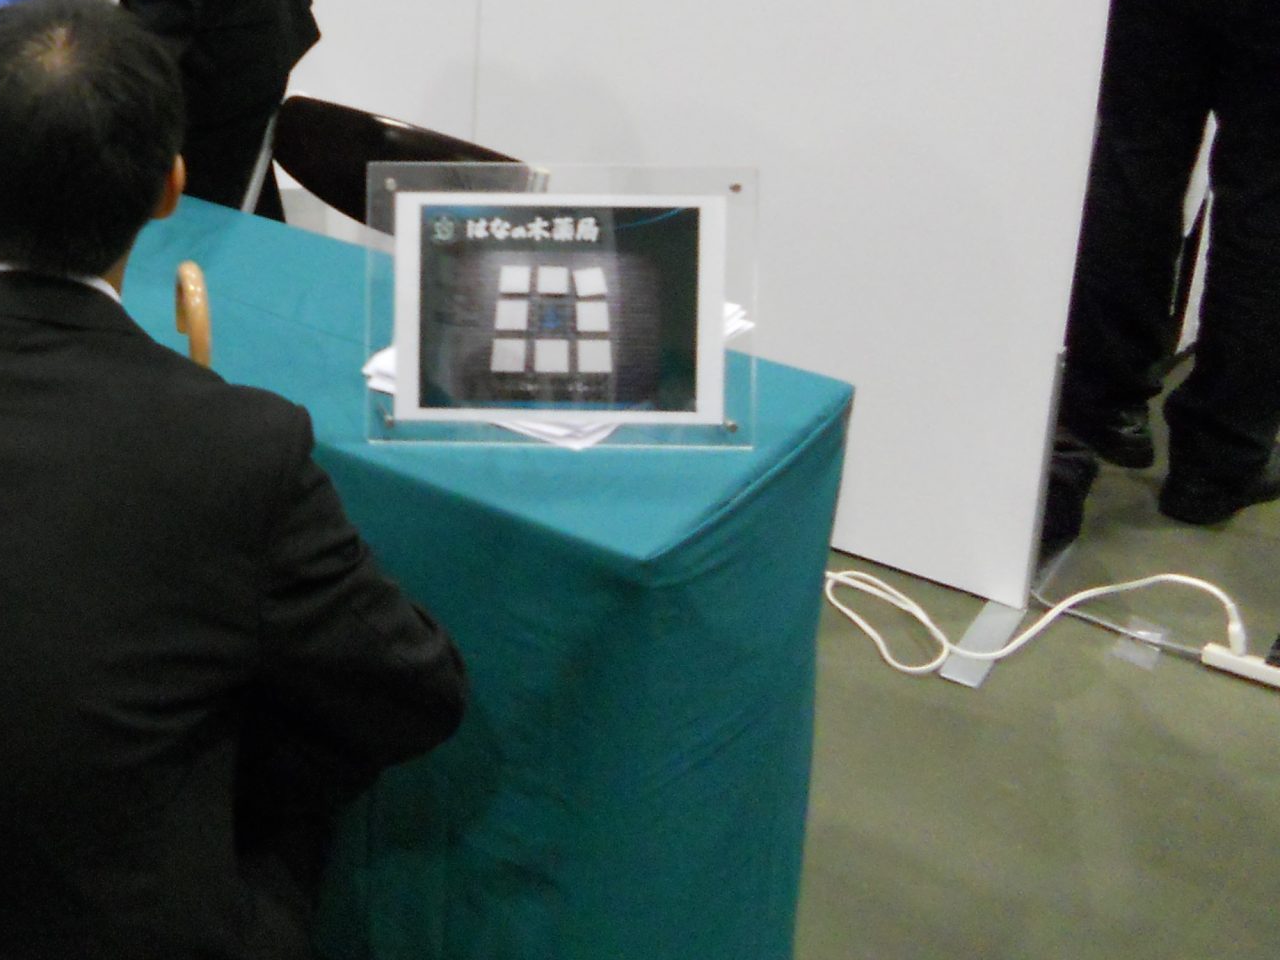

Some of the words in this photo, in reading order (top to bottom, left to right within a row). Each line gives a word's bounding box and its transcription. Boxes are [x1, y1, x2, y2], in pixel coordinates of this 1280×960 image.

[466, 216, 600, 243] はなの木薬局
